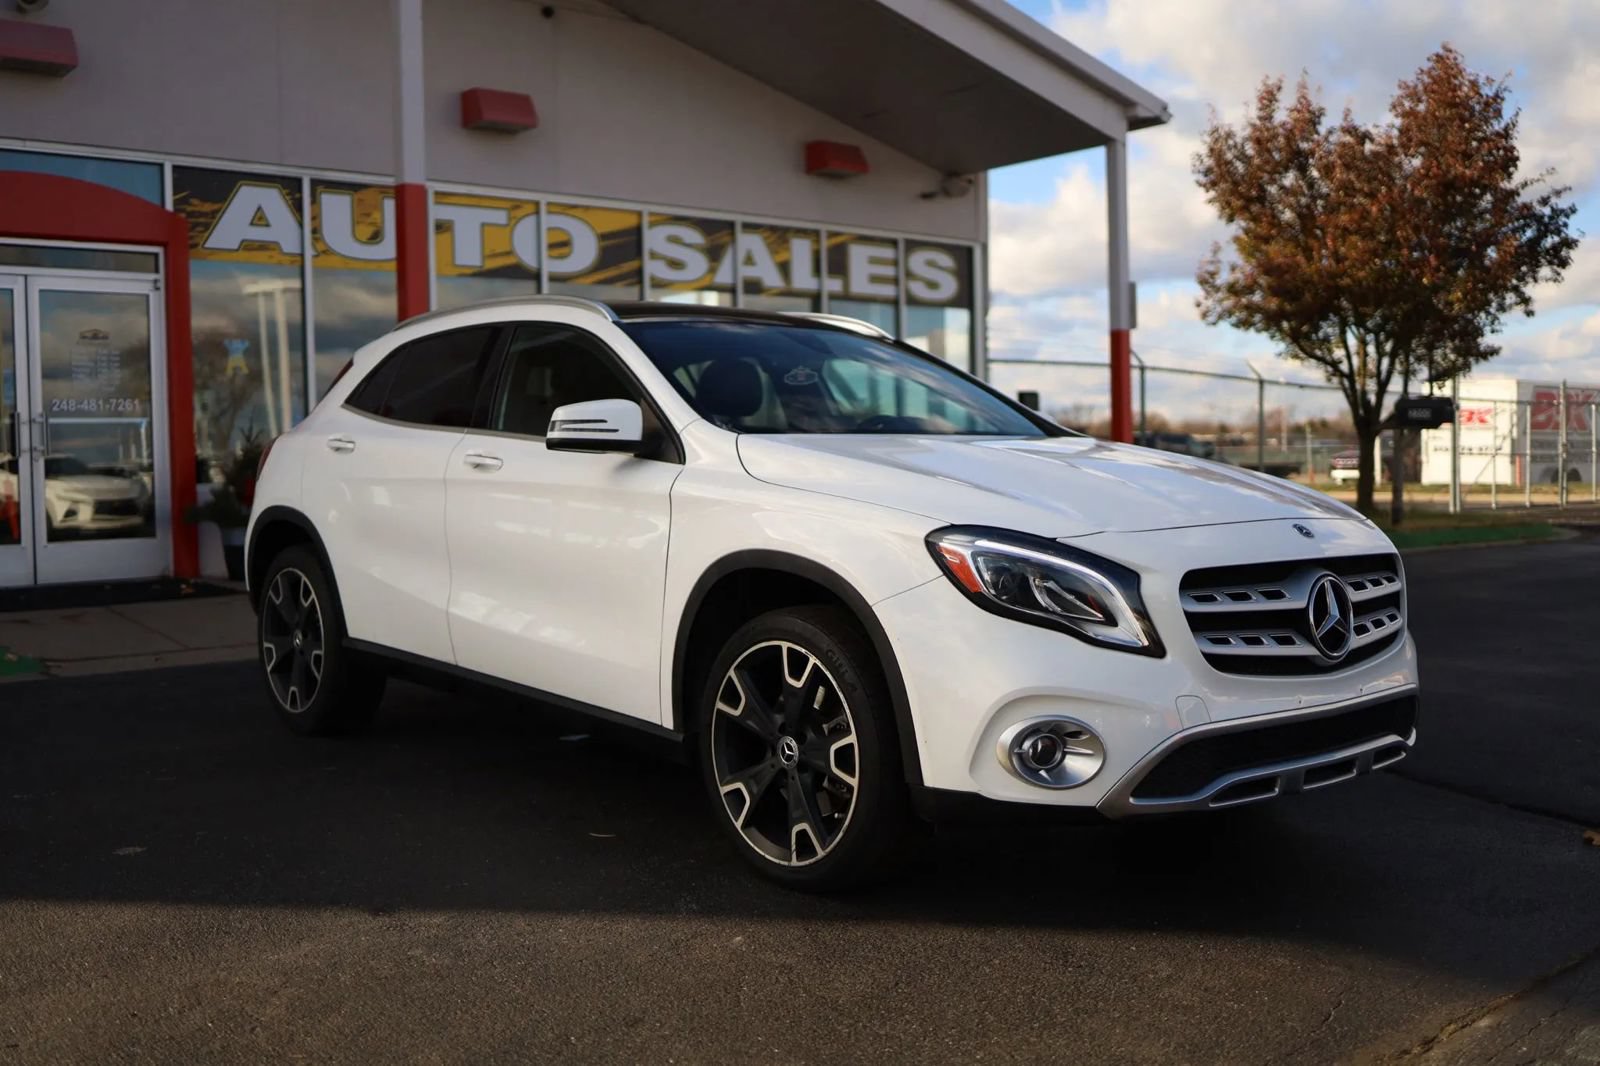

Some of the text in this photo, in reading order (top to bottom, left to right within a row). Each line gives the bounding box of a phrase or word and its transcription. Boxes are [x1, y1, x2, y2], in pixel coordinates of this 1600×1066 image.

[201, 181, 960, 301] AUTO SALES
[52, 399, 140, 411] 248-481-7261
